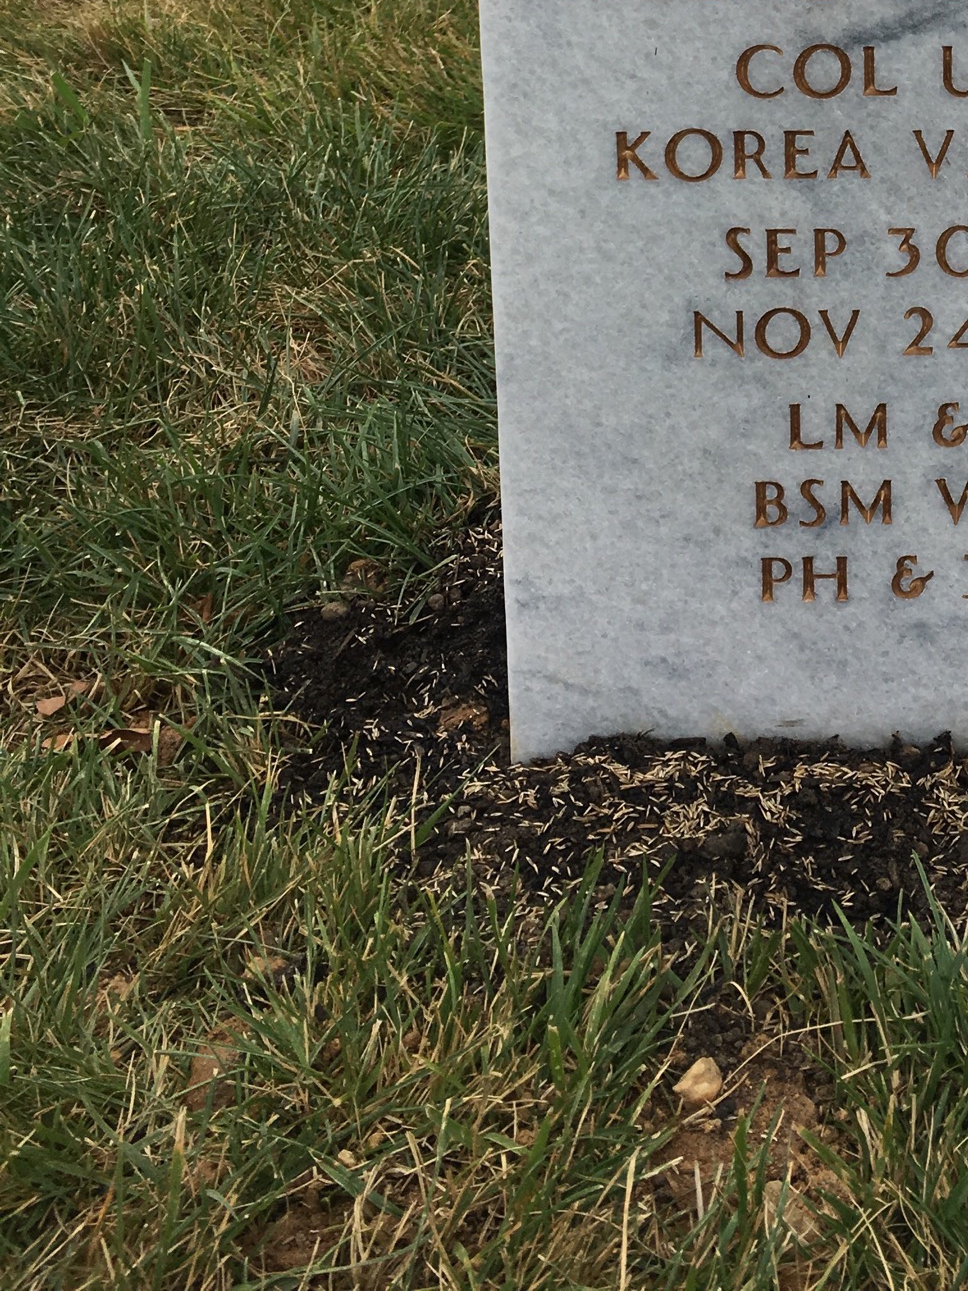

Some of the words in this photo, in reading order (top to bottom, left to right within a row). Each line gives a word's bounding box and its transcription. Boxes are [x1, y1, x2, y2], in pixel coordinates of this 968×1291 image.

[735, 43, 898, 100] COL
[616, 128, 871, 183] KOREA
[724, 226, 847, 281] SEP
[693, 307, 861, 360] NOV
[788, 402, 888, 451] LM
[754, 478, 893, 528] BSM
[761, 556, 849, 603] PH
[891, 554, 934, 599] &
